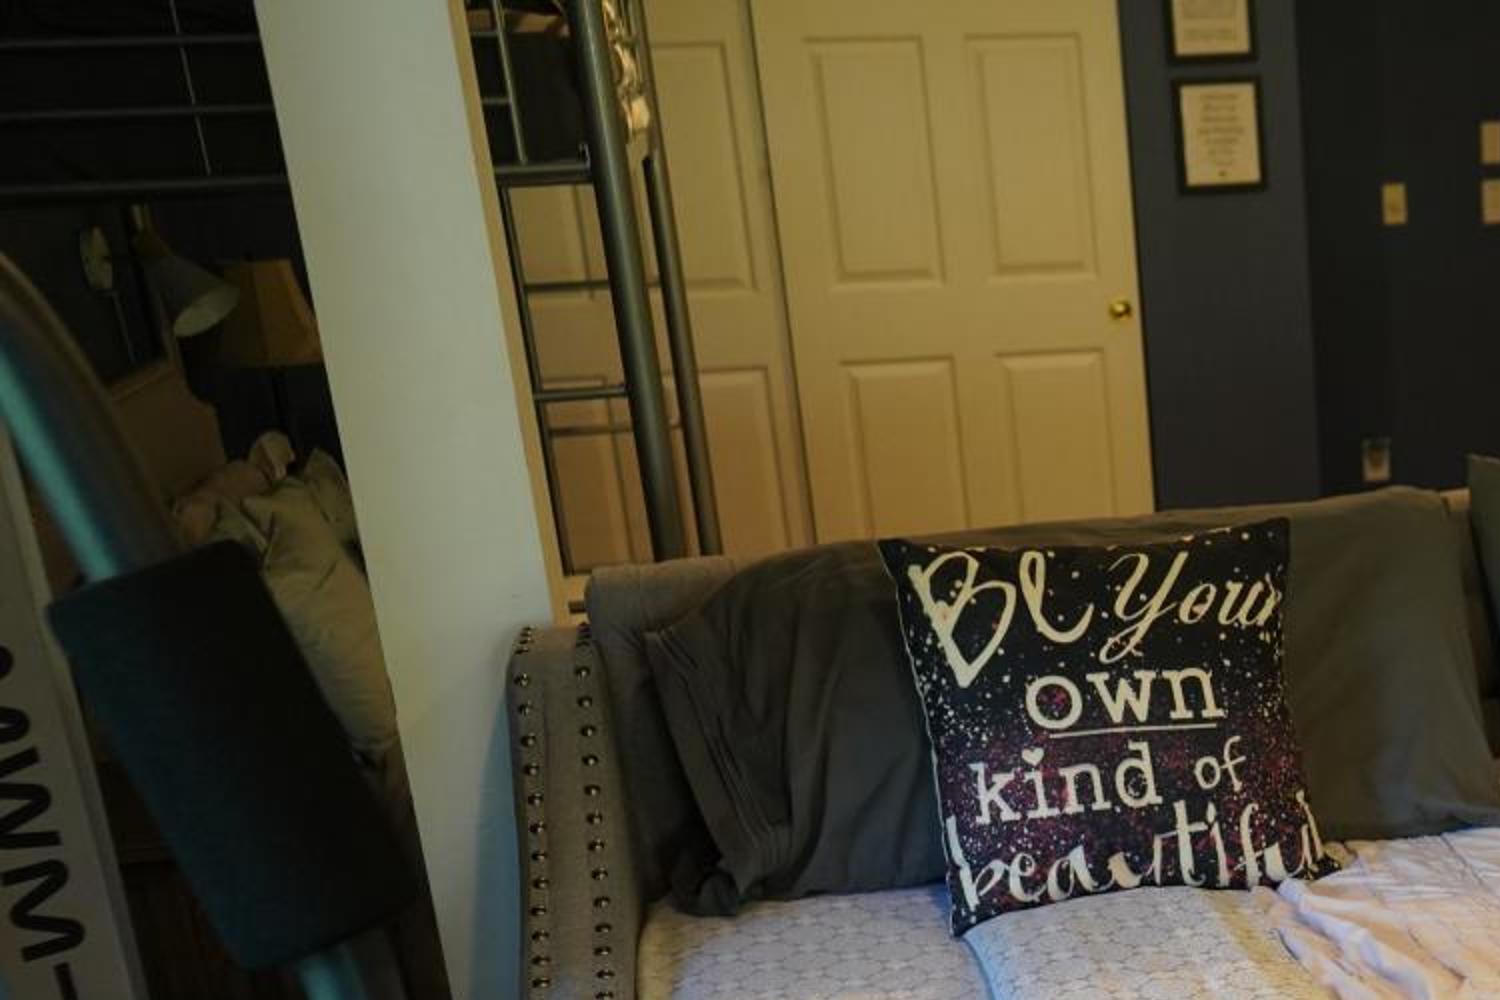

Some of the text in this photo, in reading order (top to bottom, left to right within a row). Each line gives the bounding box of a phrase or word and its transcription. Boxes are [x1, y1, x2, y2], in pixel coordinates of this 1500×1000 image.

[1026, 666, 1225, 730] own
[968, 736, 1247, 825] kind of
